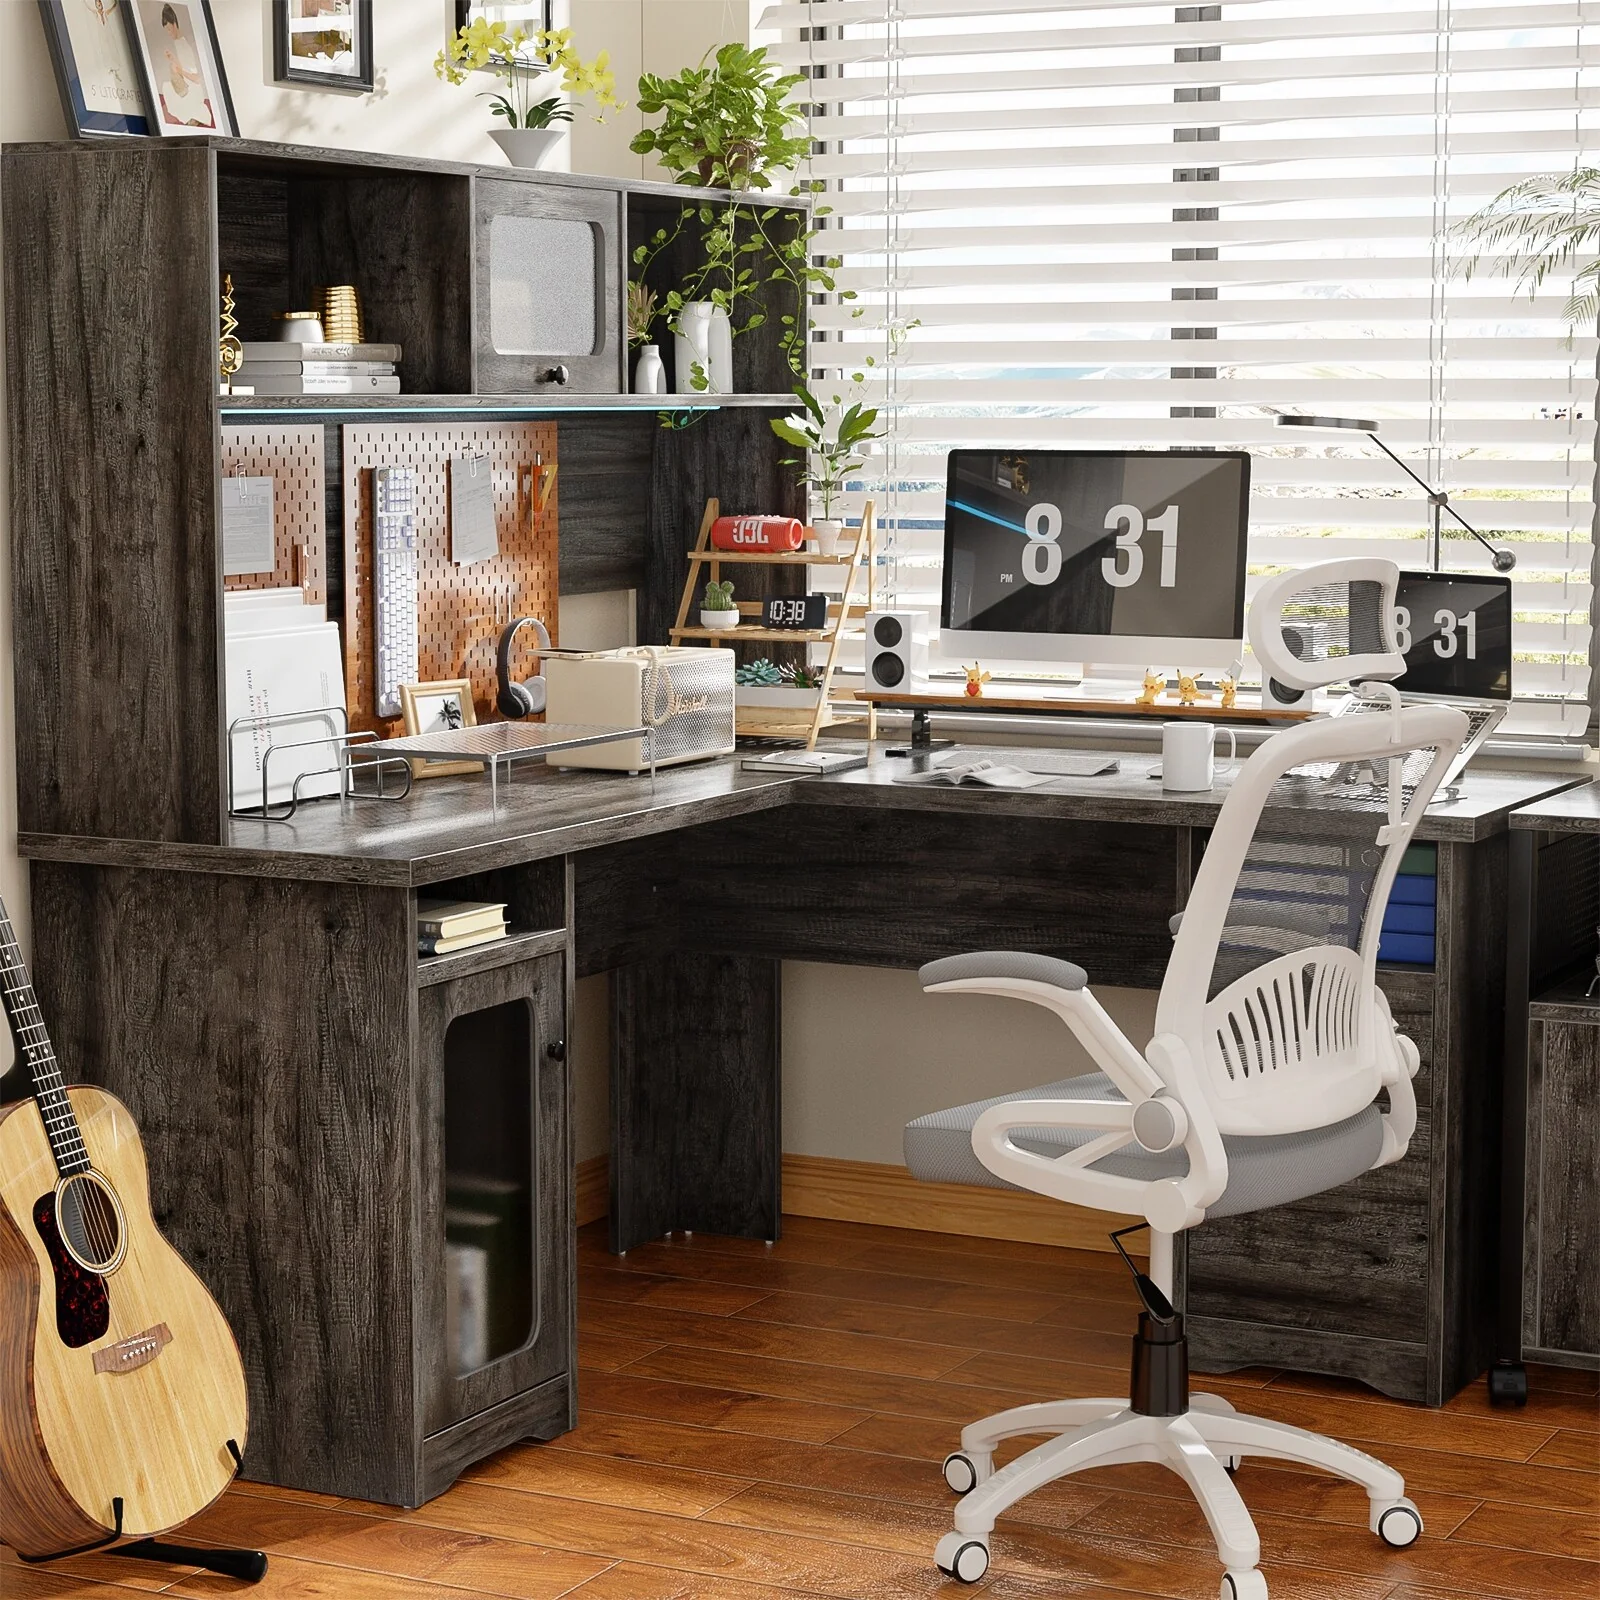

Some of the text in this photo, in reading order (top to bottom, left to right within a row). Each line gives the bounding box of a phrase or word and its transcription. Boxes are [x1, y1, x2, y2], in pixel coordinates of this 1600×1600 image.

[732, 520, 769, 543] JBL
[1021, 502, 1179, 587] 8 31
[1000, 573, 1013, 583] PM
[769, 600, 805, 621] 10:38
[1393, 605, 1476, 659] 8 31
